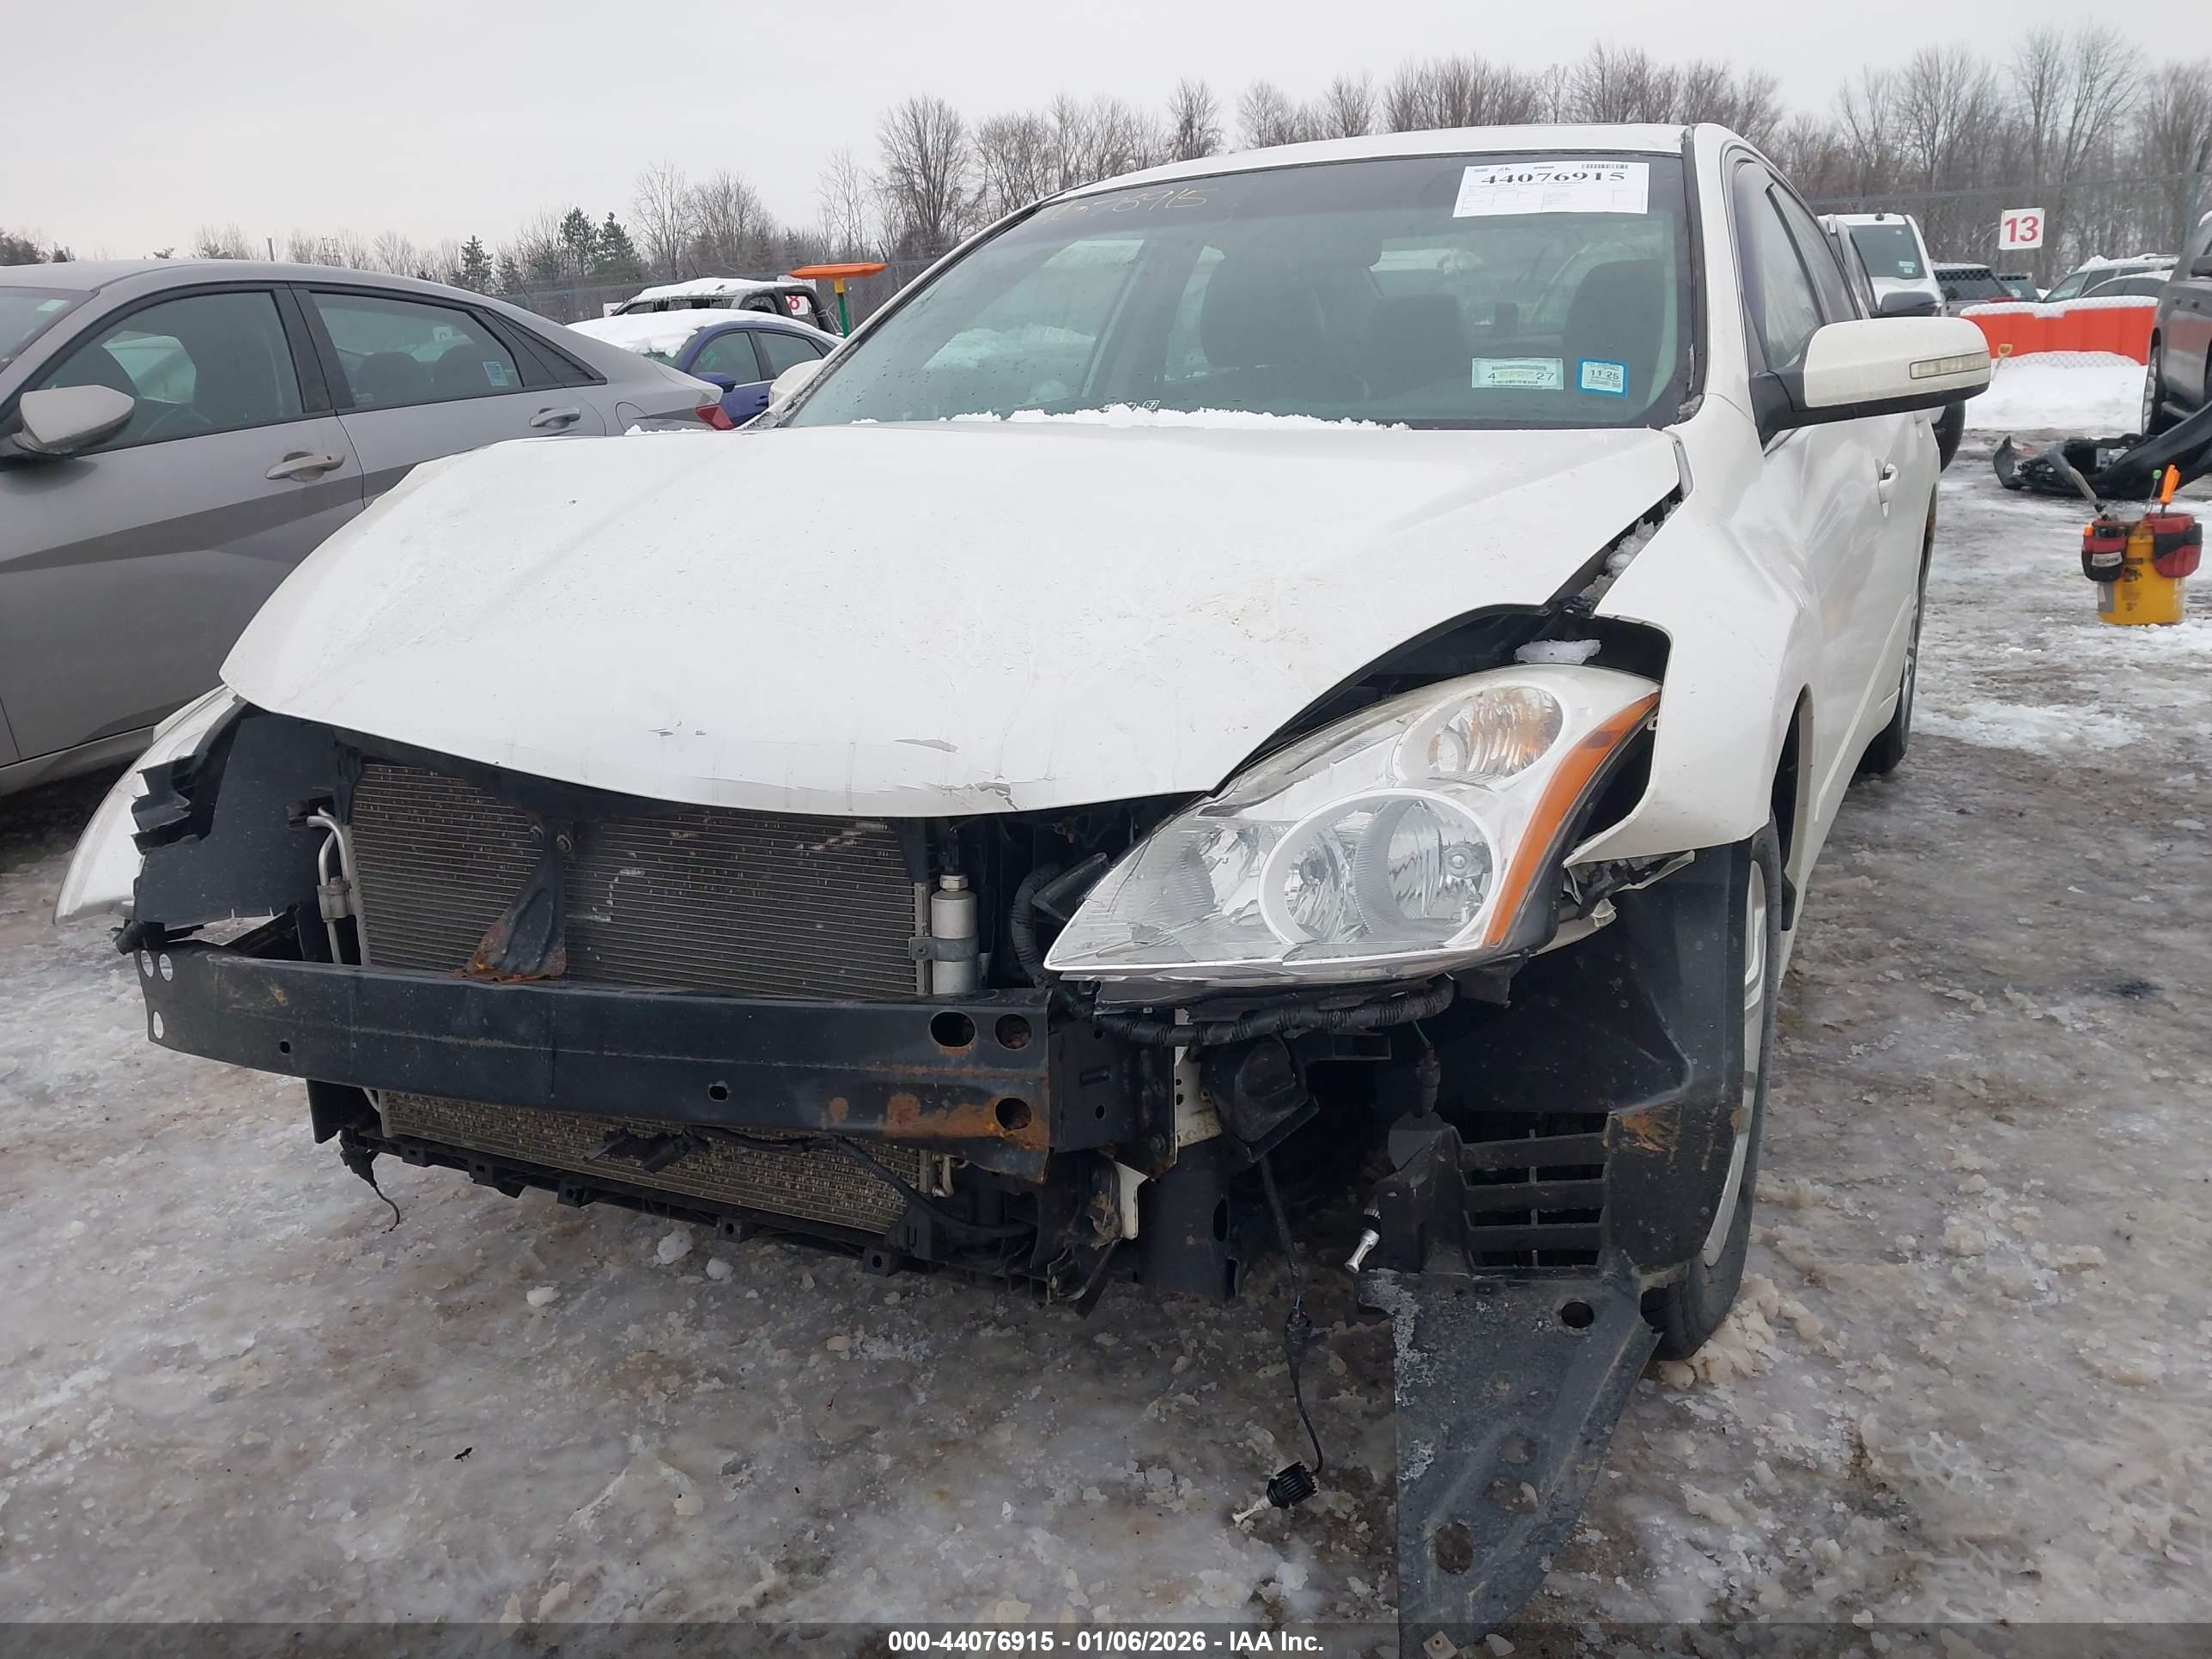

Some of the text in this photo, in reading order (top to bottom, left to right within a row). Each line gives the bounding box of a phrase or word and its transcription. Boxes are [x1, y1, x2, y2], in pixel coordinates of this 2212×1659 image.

[1481, 172, 1625, 185] 44076915
[2005, 216, 2039, 242] 13
[1487, 372, 1554, 380] 4 27
[1606, 371, 1620, 380] 25
